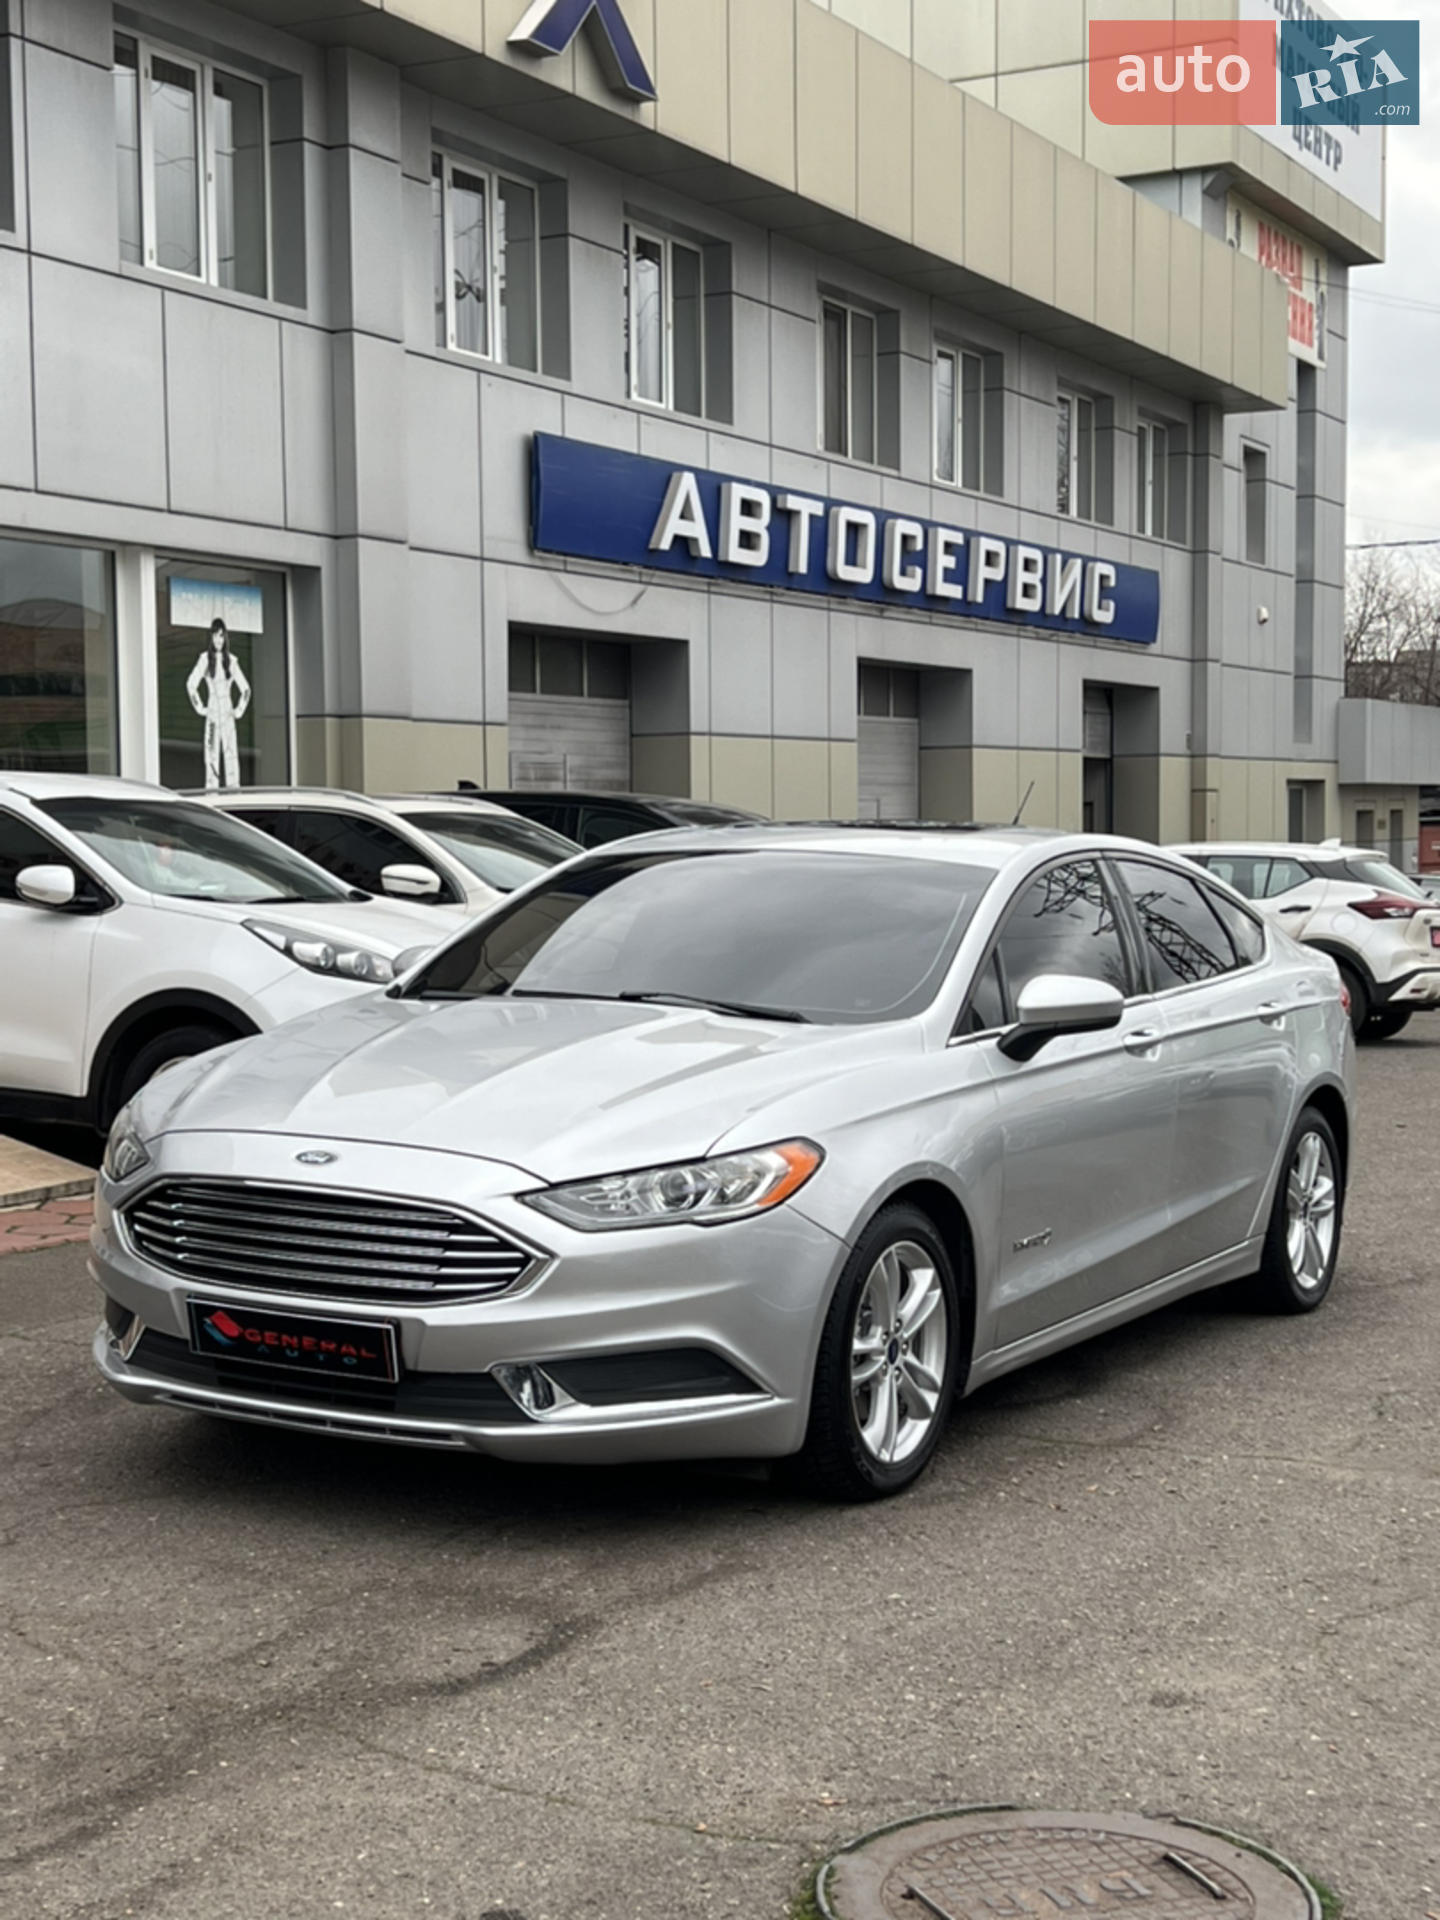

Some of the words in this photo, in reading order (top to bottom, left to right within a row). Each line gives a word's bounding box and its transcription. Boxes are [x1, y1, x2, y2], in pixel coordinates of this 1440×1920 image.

[1291, 106, 1343, 172] ЦЕНТР
[648, 471, 1116, 624] АВТОСЕРВИС
[243, 1328, 377, 1359] GENERAL
[257, 1344, 358, 1366] AUTO
